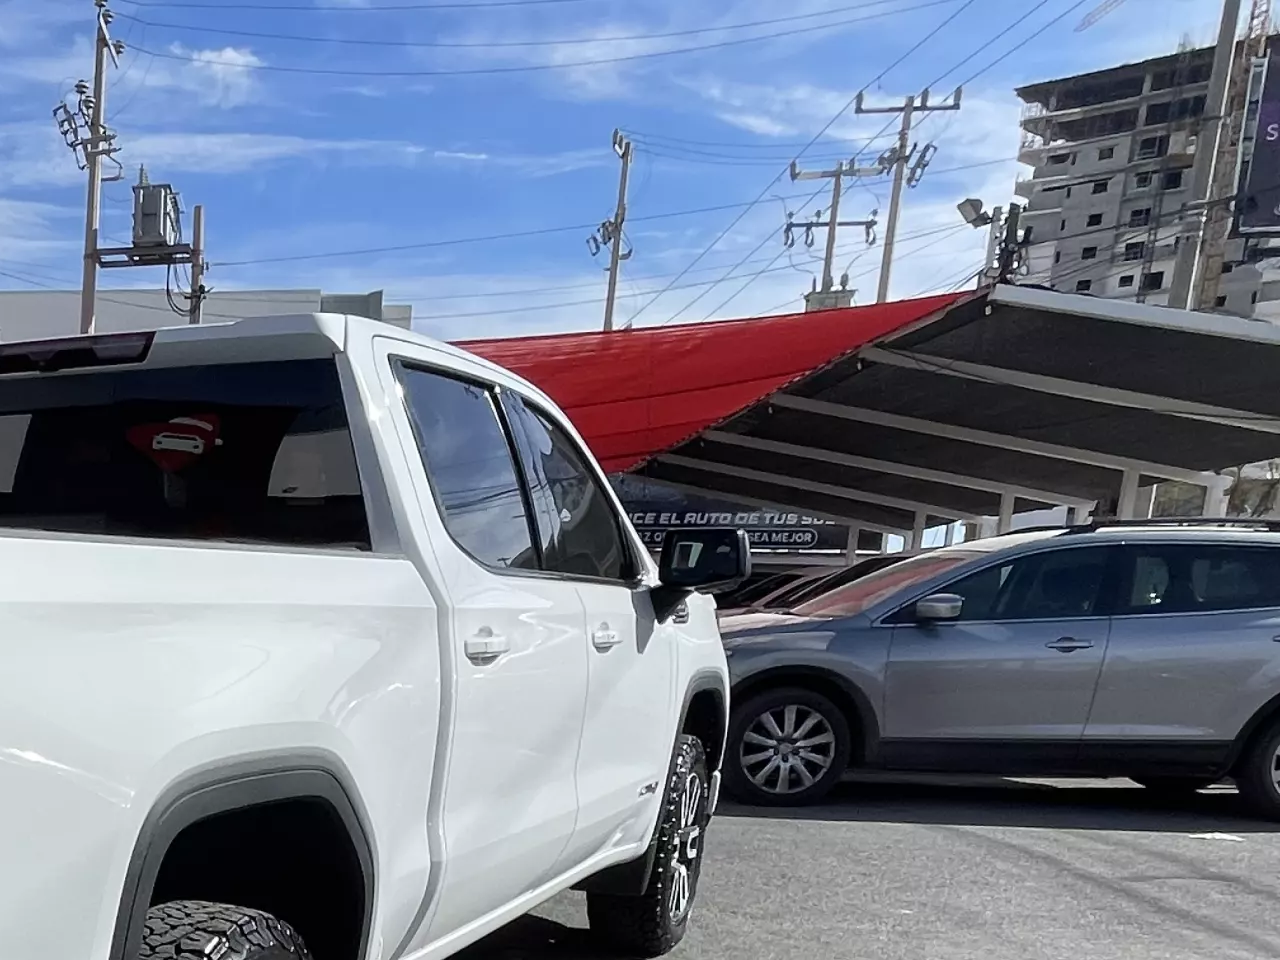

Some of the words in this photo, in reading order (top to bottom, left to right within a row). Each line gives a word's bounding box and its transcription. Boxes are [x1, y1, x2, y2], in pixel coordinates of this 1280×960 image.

[660, 513, 680, 524] EL
[684, 513, 732, 524] AUTO
[735, 513, 760, 524] DE
[764, 513, 798, 524] TUS
[771, 533, 812, 542] MEJOR
